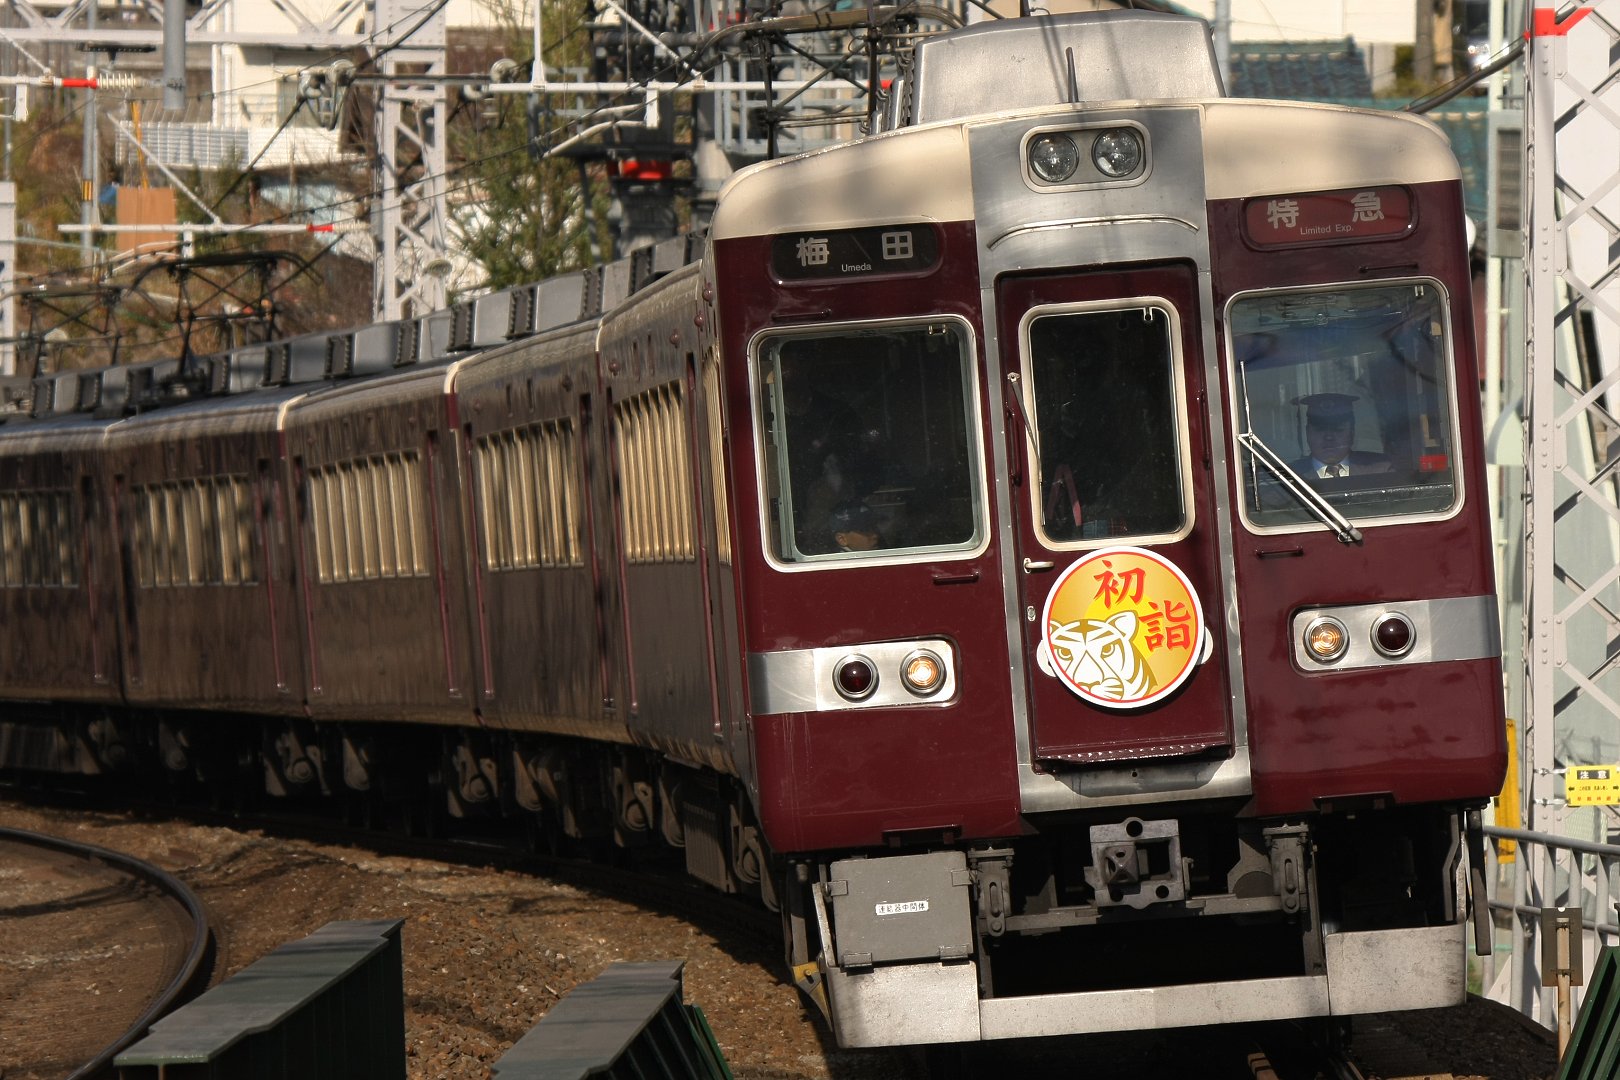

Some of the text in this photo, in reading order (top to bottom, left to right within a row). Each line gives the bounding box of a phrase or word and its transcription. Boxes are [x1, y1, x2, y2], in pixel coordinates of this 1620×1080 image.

[1267, 191, 1385, 229] 特急
[1300, 224, 1354, 235] Limited Exp.
[796, 231, 914, 267] 梅田
[841, 263, 872, 273] Umeda
[1093, 559, 1191, 652] 初詣
